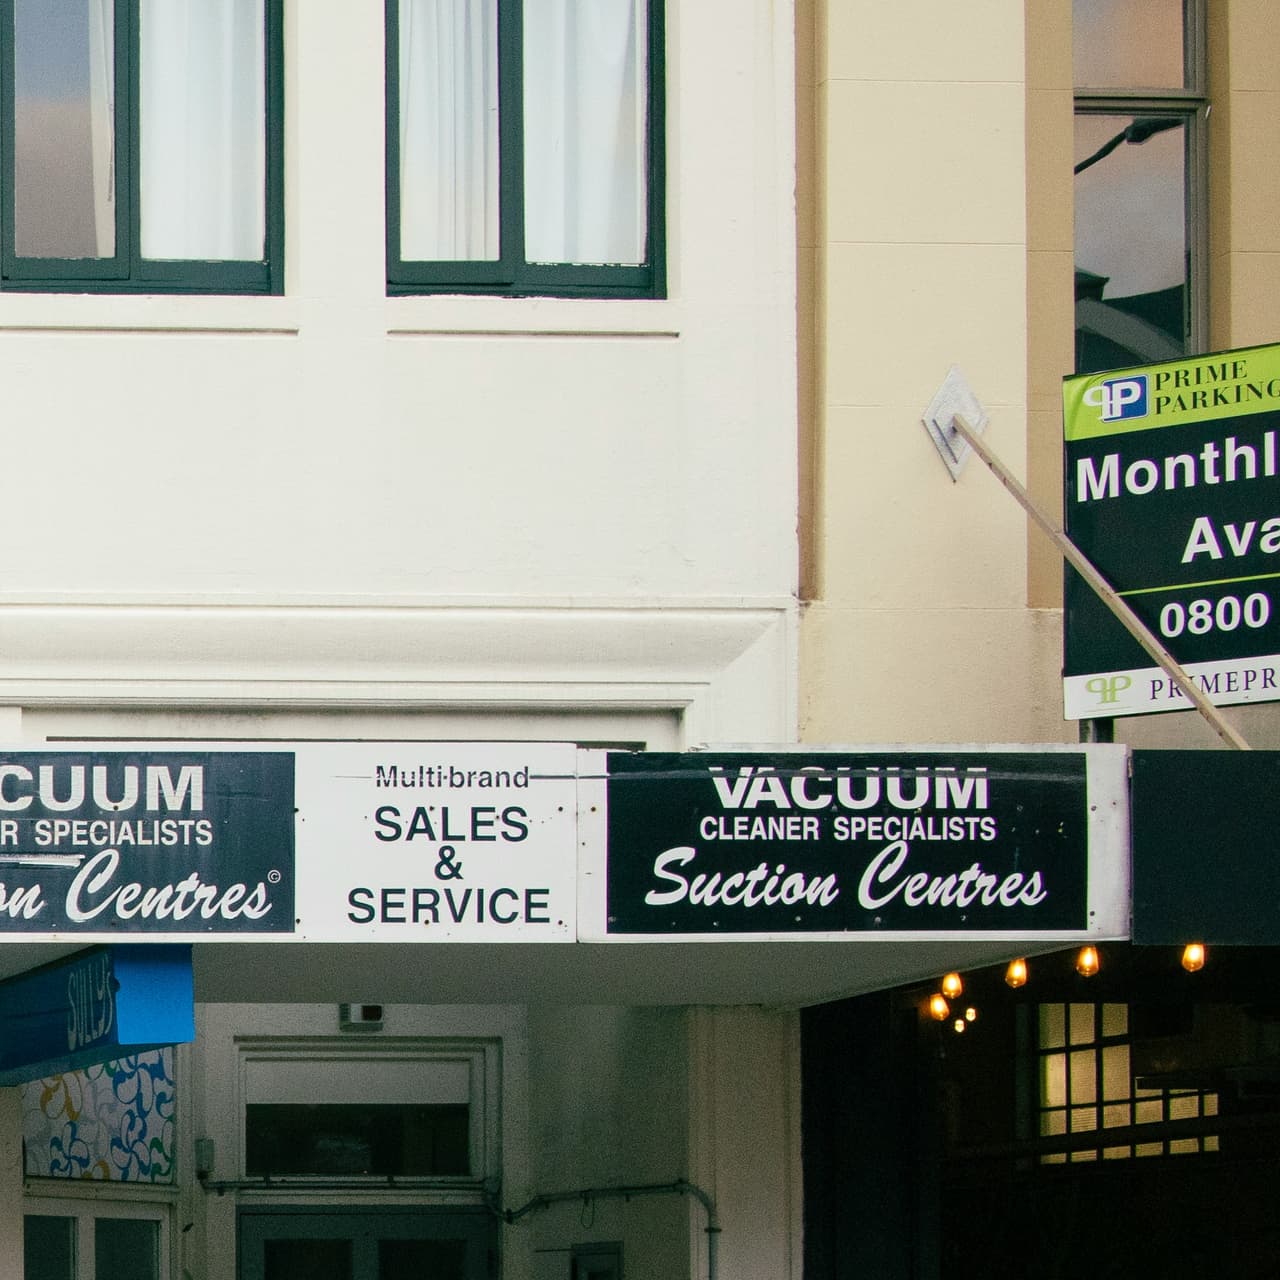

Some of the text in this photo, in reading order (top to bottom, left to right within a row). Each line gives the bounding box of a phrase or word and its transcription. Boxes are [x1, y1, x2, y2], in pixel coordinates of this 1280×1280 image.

[1155, 360, 1248, 391] PRIME
[1160, 592, 1270, 638] 0800
[1150, 668, 1278, 700] PRMEPR
[709, 766, 988, 809] VACUUM
[34, 820, 213, 847] SPECIALISTS
[374, 806, 528, 842] SALES
[700, 816, 996, 842] CLEANER SPECIALISTS
[435, 846, 464, 880] &
[645, 841, 1047, 910] Suction Centres
[347, 888, 550, 924] SERVICE
